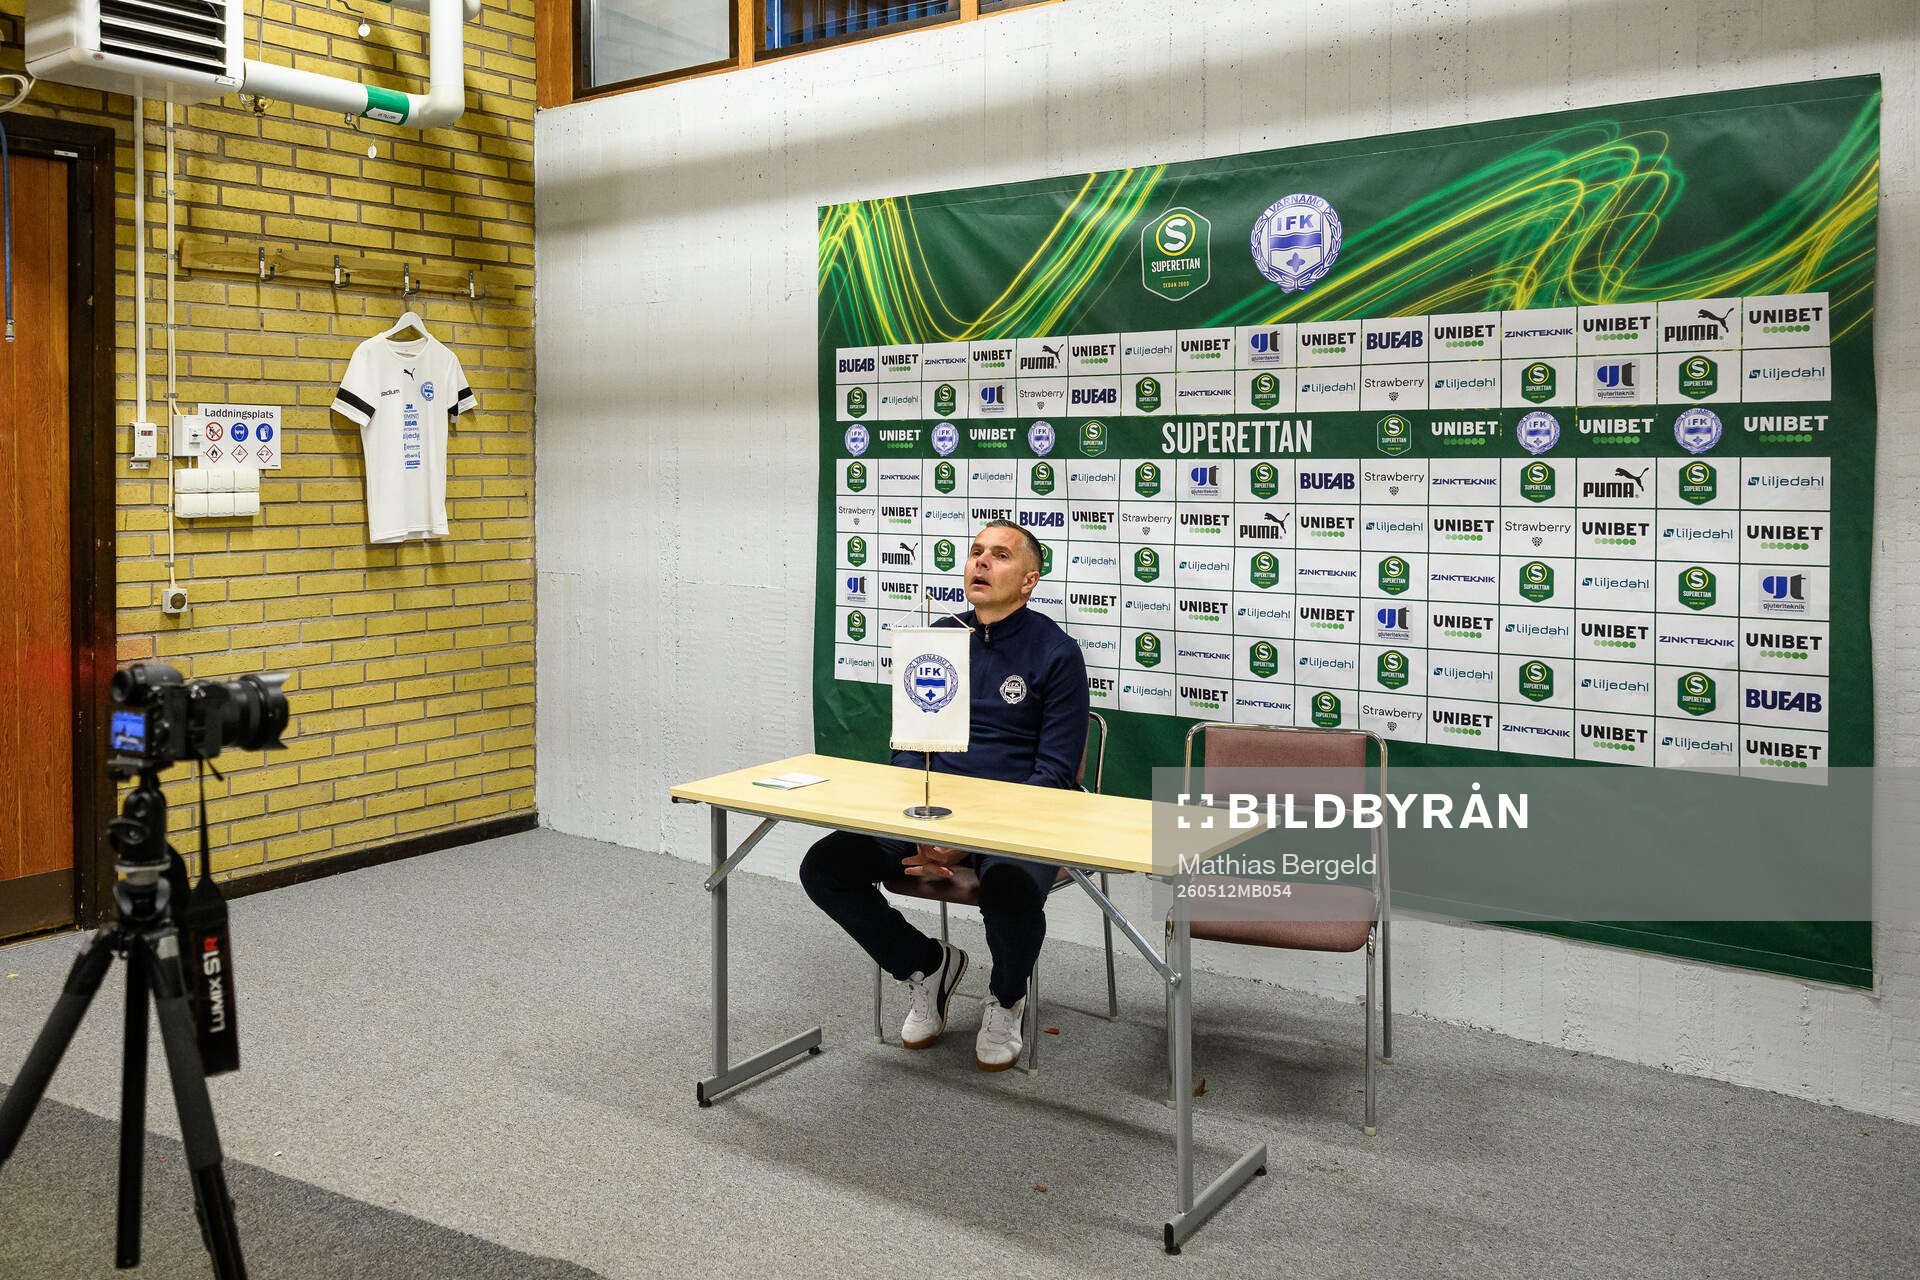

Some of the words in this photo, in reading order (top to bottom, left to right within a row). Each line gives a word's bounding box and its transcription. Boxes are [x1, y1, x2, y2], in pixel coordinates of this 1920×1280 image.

[1277, 214, 1313, 231] IFK
[1151, 258, 1200, 273] SUPERETTAN
[1749, 308, 1822, 324] UNIBET
[1583, 317, 1650, 332] UNIBET
[1435, 325, 1495, 339] UNIBET
[1505, 328, 1573, 337] ZINKTEKNIK
[1665, 325, 1718, 342] PUMA
[1181, 339, 1230, 352] UNIBET
[1302, 333, 1356, 346] UNIBET
[1367, 330, 1423, 350] BUFAB
[973, 350, 1012, 361] UNIBET
[1072, 345, 1116, 358] UNIBET
[839, 358, 874, 373] BUFAB
[882, 354, 918, 365] UNIBET
[1021, 357, 1055, 369] PUMA
[1365, 378, 1424, 388] Strawberry
[1020, 389, 1064, 398] Strawberry
[1072, 389, 1116, 404] BUFAB
[205, 408, 274, 420] Laddningsplats
[1431, 421, 1498, 436] UNIBET
[1579, 419, 1654, 433] UNIBET
[1744, 416, 1828, 431] UNIBET
[880, 430, 921, 441] UNIBET
[970, 429, 1016, 440] UNIBET
[1162, 420, 1312, 454] SUPERETTAN
[1300, 473, 1355, 490] BUFAB
[1365, 472, 1424, 483] Strawberry
[1583, 483, 1634, 497] PUMA
[839, 507, 875, 516] Strawberry
[882, 507, 918, 517] UNIBET
[972, 509, 1012, 520] UNIBET
[1072, 512, 1114, 523] UNIBET
[1122, 513, 1172, 524] Strawberry
[1020, 512, 1064, 527] BUFAB
[1180, 514, 1230, 526] UNIBET
[1301, 517, 1354, 529] UNIBET
[1434, 519, 1494, 532] UNIBET
[1240, 525, 1279, 539] PUMA
[1505, 522, 1571, 534] Strawberry
[1582, 522, 1649, 536] UNIBET
[1747, 526, 1823, 540] UNIBET
[882, 553, 911, 565] PUMA
[1298, 569, 1357, 577] ZINKTEKNIK
[1431, 574, 1495, 583] ZINKTEKNIK
[882, 582, 918, 593] UNIBET
[1070, 594, 1116, 606] UNIBET
[1180, 600, 1228, 614] UNIBET
[1300, 607, 1355, 622] UNIBET
[1433, 615, 1493, 630] UNIBET
[1581, 624, 1648, 639] UNIBET
[1659, 636, 1734, 647] ZINKTEKNIK
[1746, 633, 1822, 650] UNIBET
[1178, 650, 1230, 660] ZINKTEKNIK
[920, 667, 941, 676] IFK
[1089, 677, 1114, 691] IBET
[1181, 687, 1228, 701] UNIBET
[1746, 689, 1822, 712] BUFAB
[1236, 699, 1291, 710] ZINKTEKNIK
[1363, 705, 1422, 720] Strawberry
[1433, 711, 1493, 727] UNIBET
[1503, 724, 1570, 738] ZINKTEKNIK
[1581, 724, 1648, 743] UNIBET
[1746, 740, 1821, 760] UNIBET
[202, 936, 221, 976] S1R
[208, 976, 226, 1033] LUMIX
